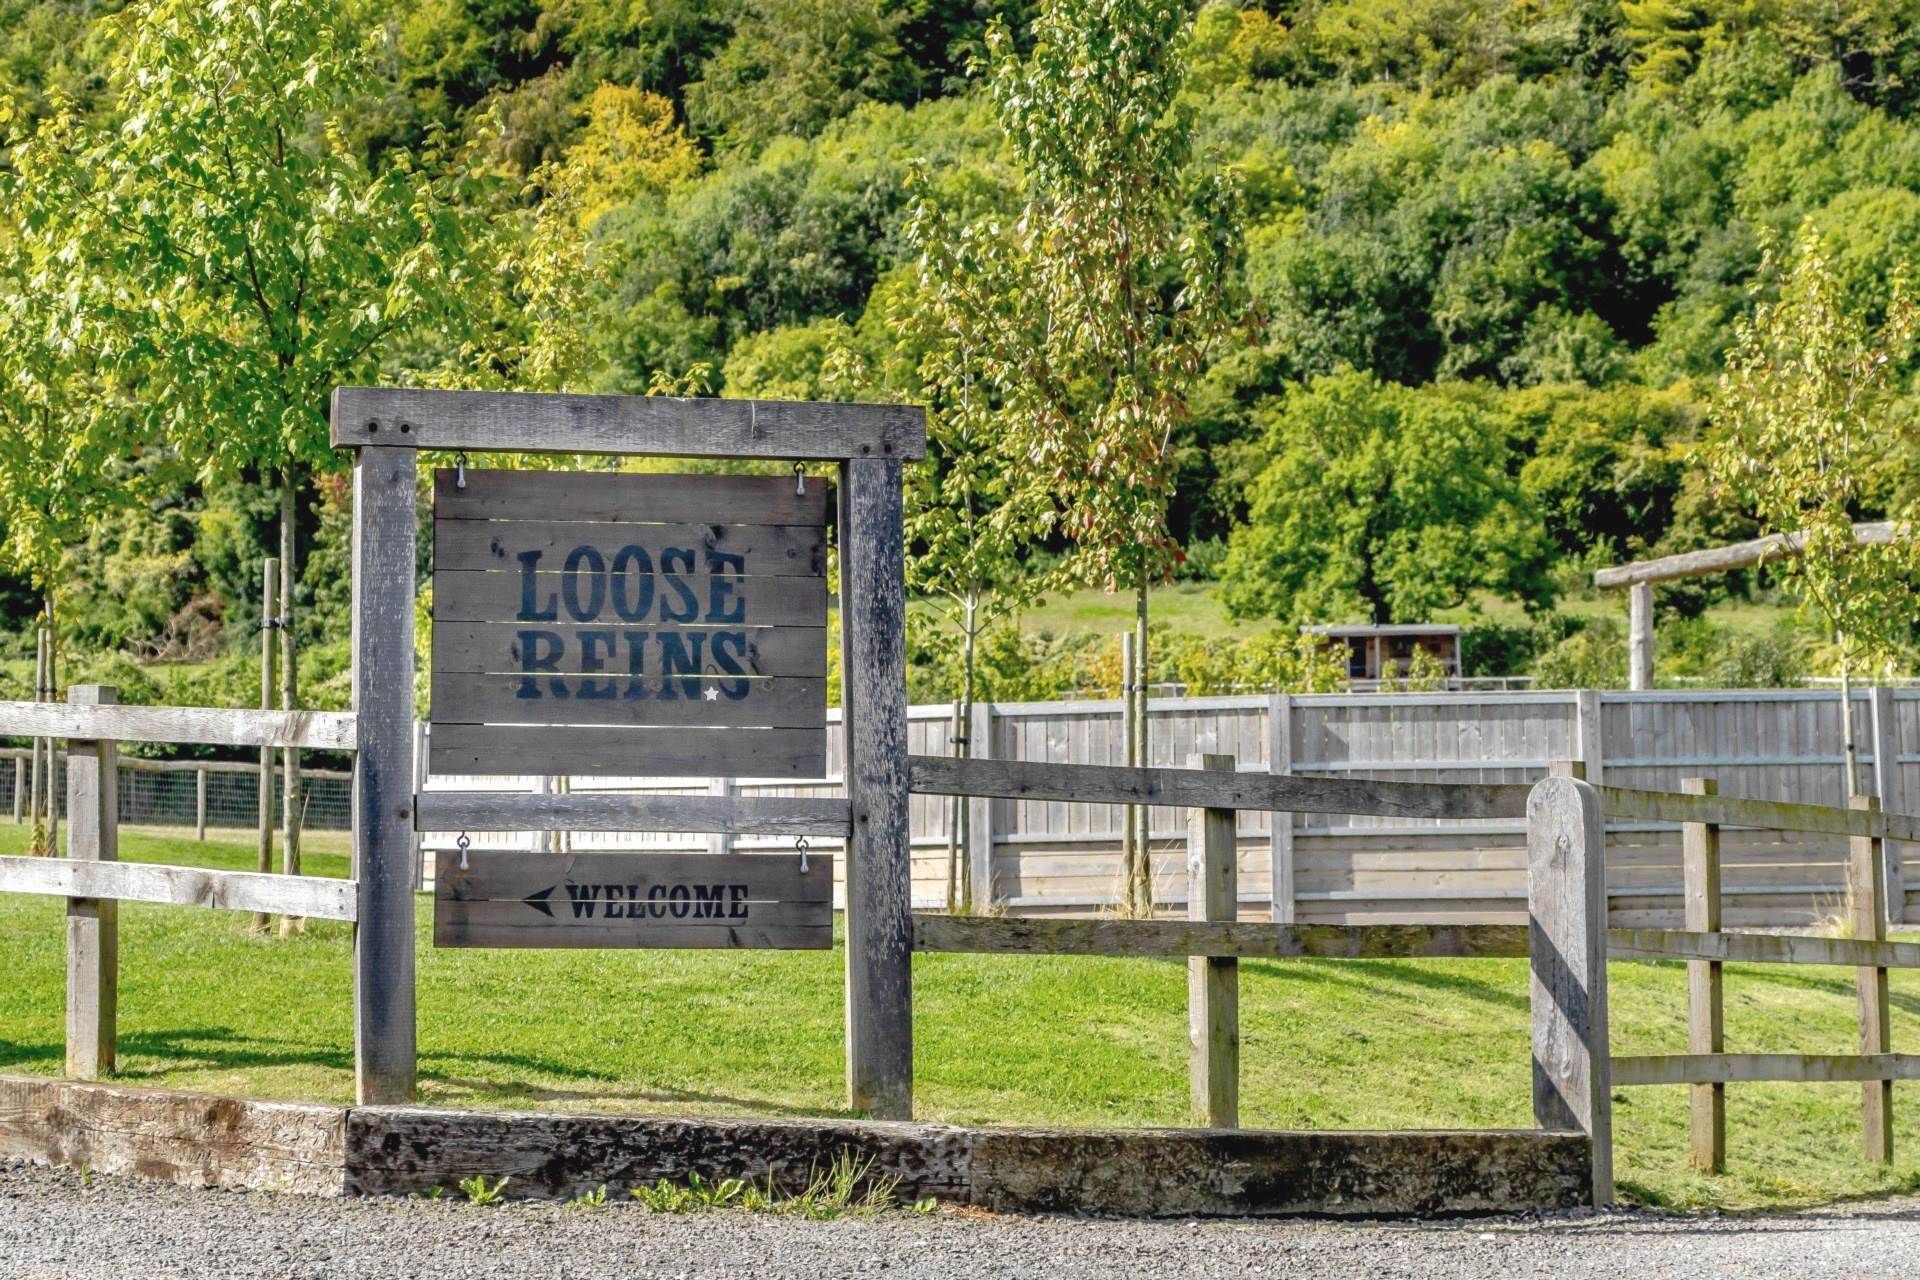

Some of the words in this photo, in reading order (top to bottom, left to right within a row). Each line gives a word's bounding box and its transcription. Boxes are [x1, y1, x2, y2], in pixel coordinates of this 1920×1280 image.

[516, 544, 746, 623] LOOSE
[516, 630, 750, 700] REINS
[565, 884, 748, 919] WELCOME
